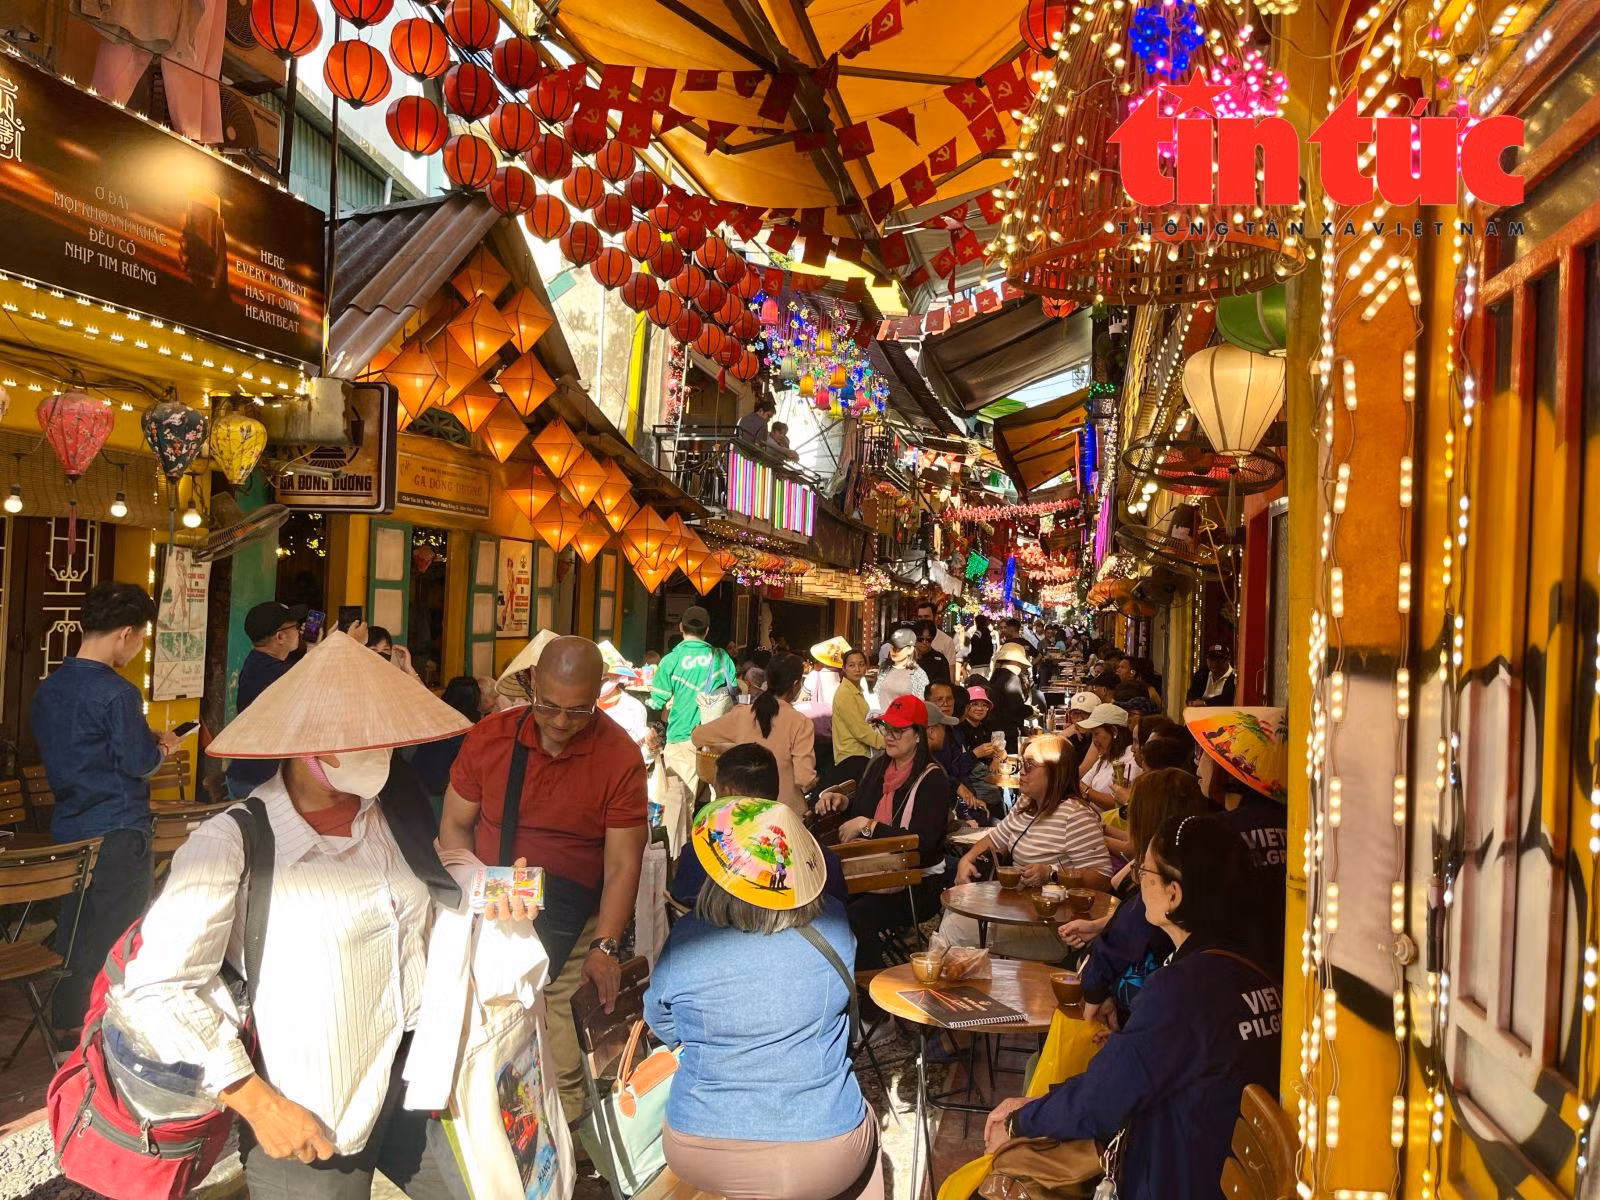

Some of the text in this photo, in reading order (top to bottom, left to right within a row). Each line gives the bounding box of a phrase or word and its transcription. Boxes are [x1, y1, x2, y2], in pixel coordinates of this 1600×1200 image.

[118, 239, 136, 256] CÓ
[260, 250, 286, 271] HERE
[65, 241, 157, 285] NHỊP TIM RIÊNG
[236, 260, 308, 298] EVERY MOMENT
[245, 284, 300, 315] HAS IT OWN
[245, 304, 300, 333] HEARTBEAT
